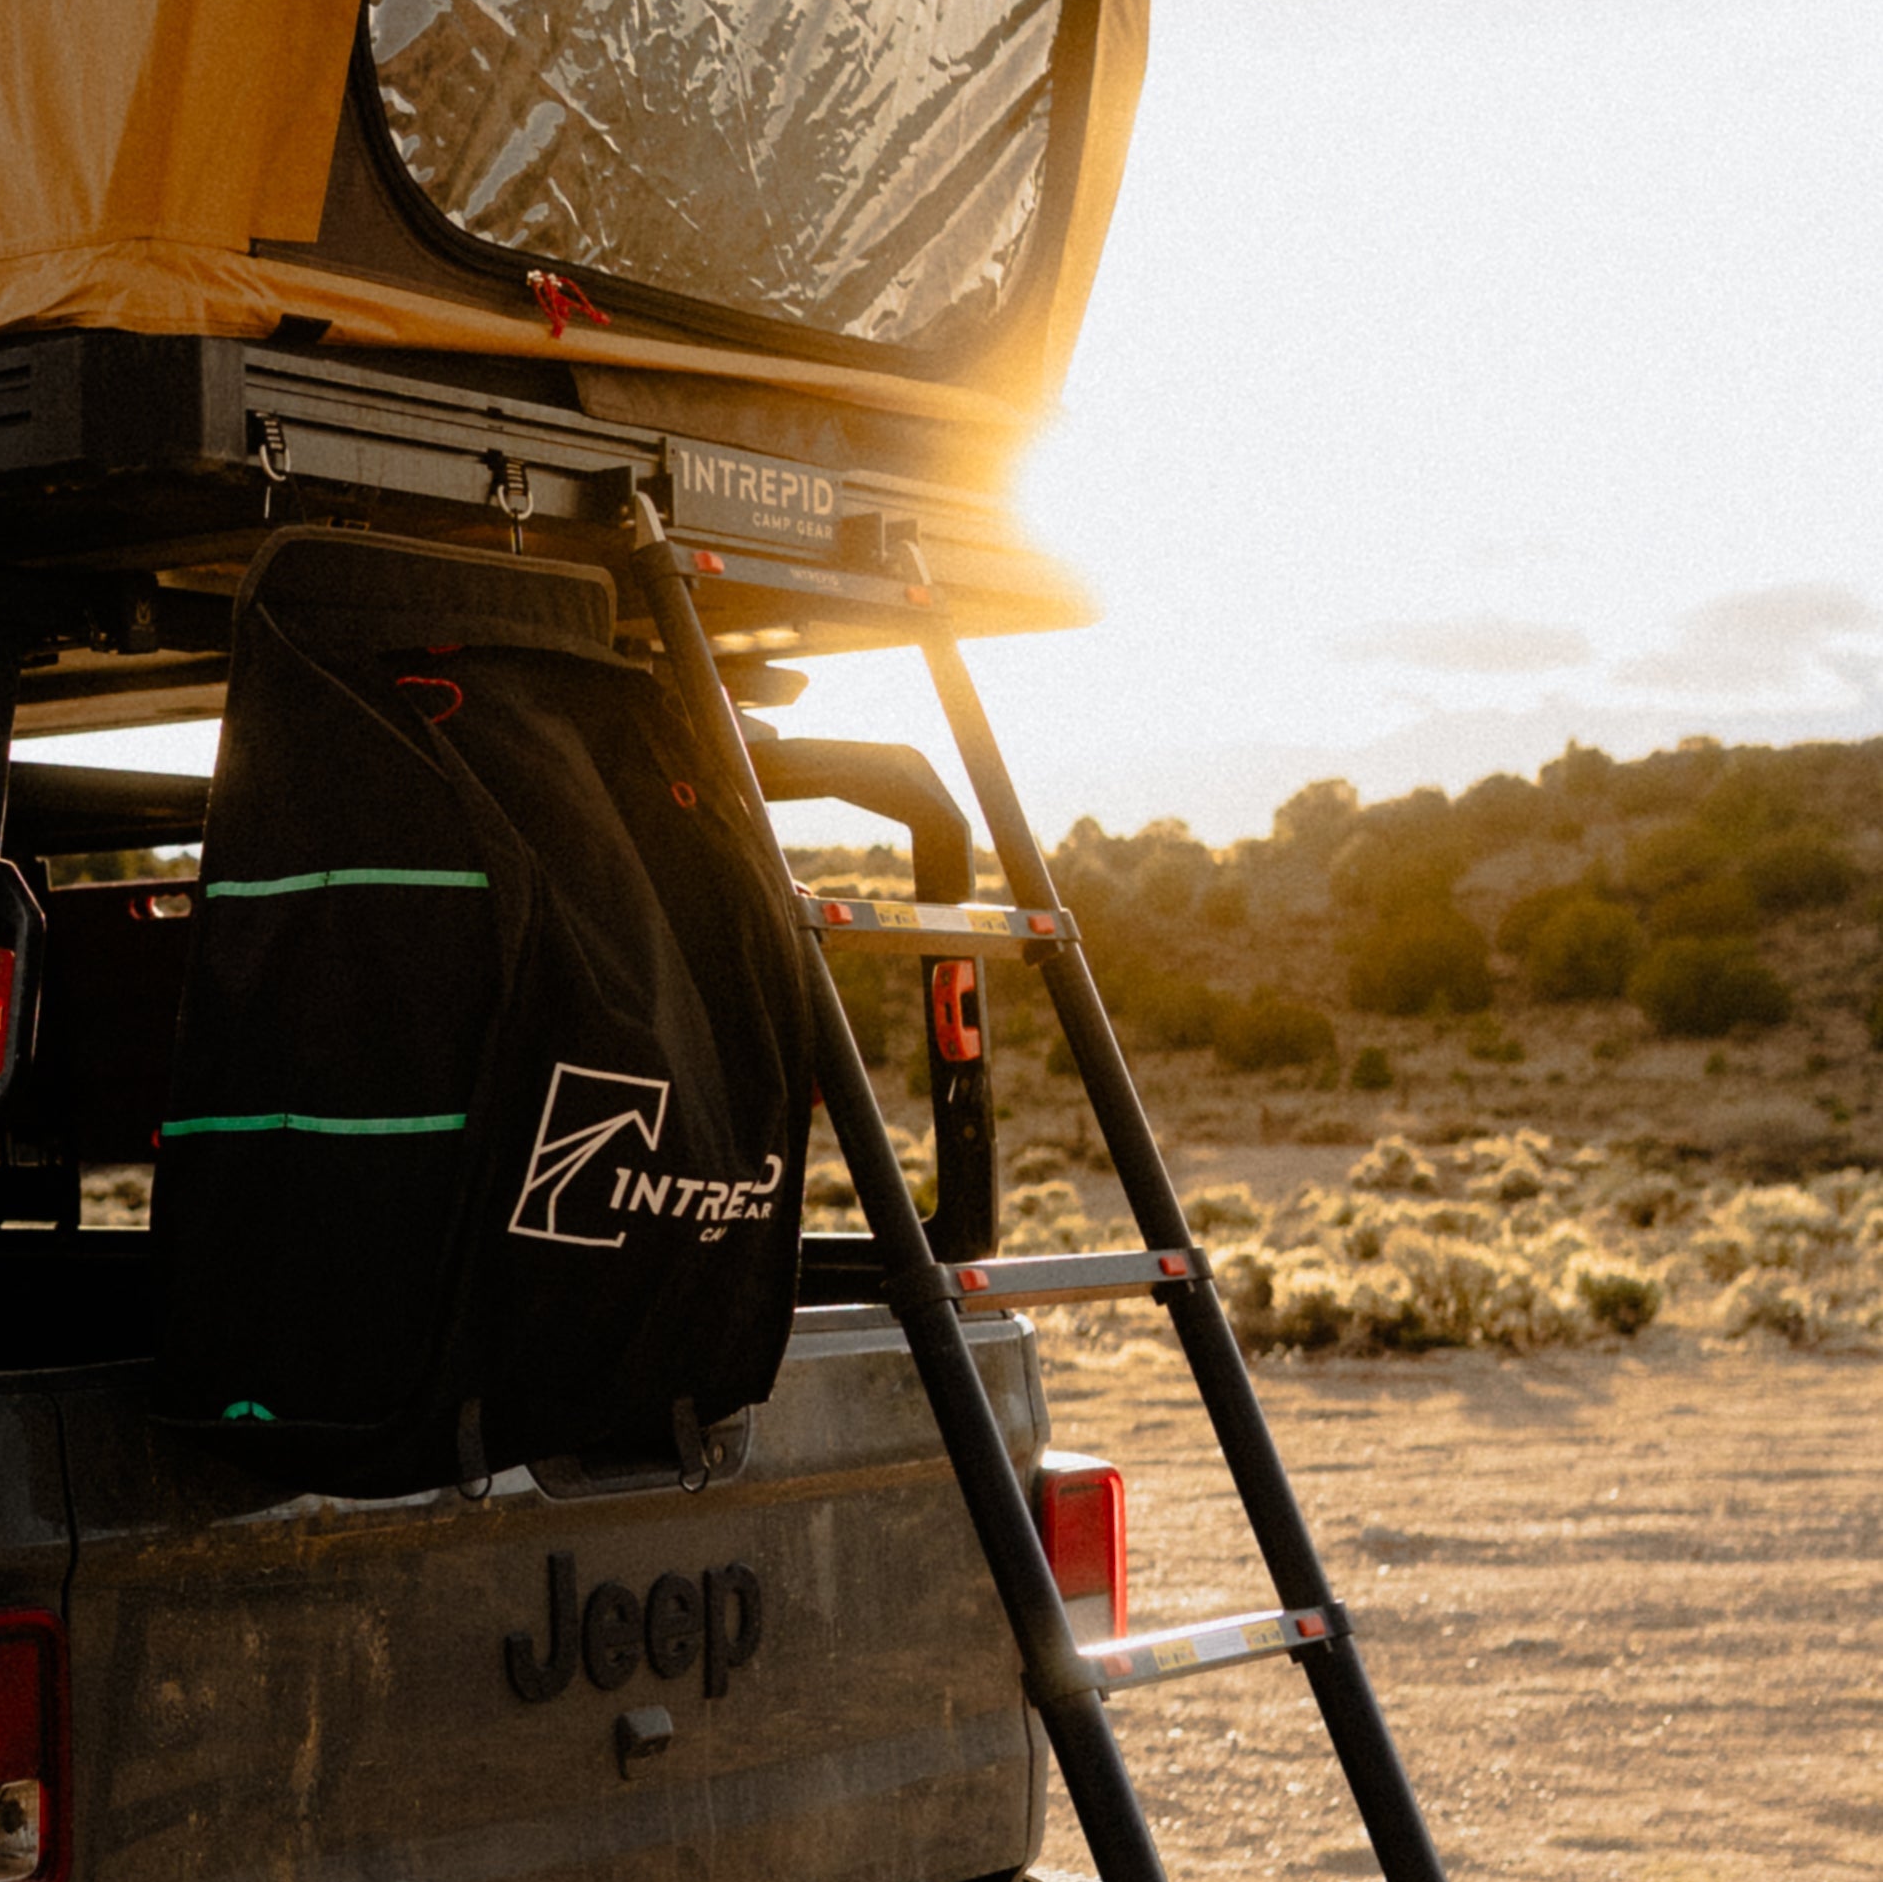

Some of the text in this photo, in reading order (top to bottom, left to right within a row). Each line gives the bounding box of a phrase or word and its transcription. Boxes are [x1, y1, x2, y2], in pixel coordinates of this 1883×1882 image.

[678, 449, 835, 516] INTREPID
[752, 511, 835, 542] CAMP GEAR
[502, 1550, 763, 1705] Jeep
